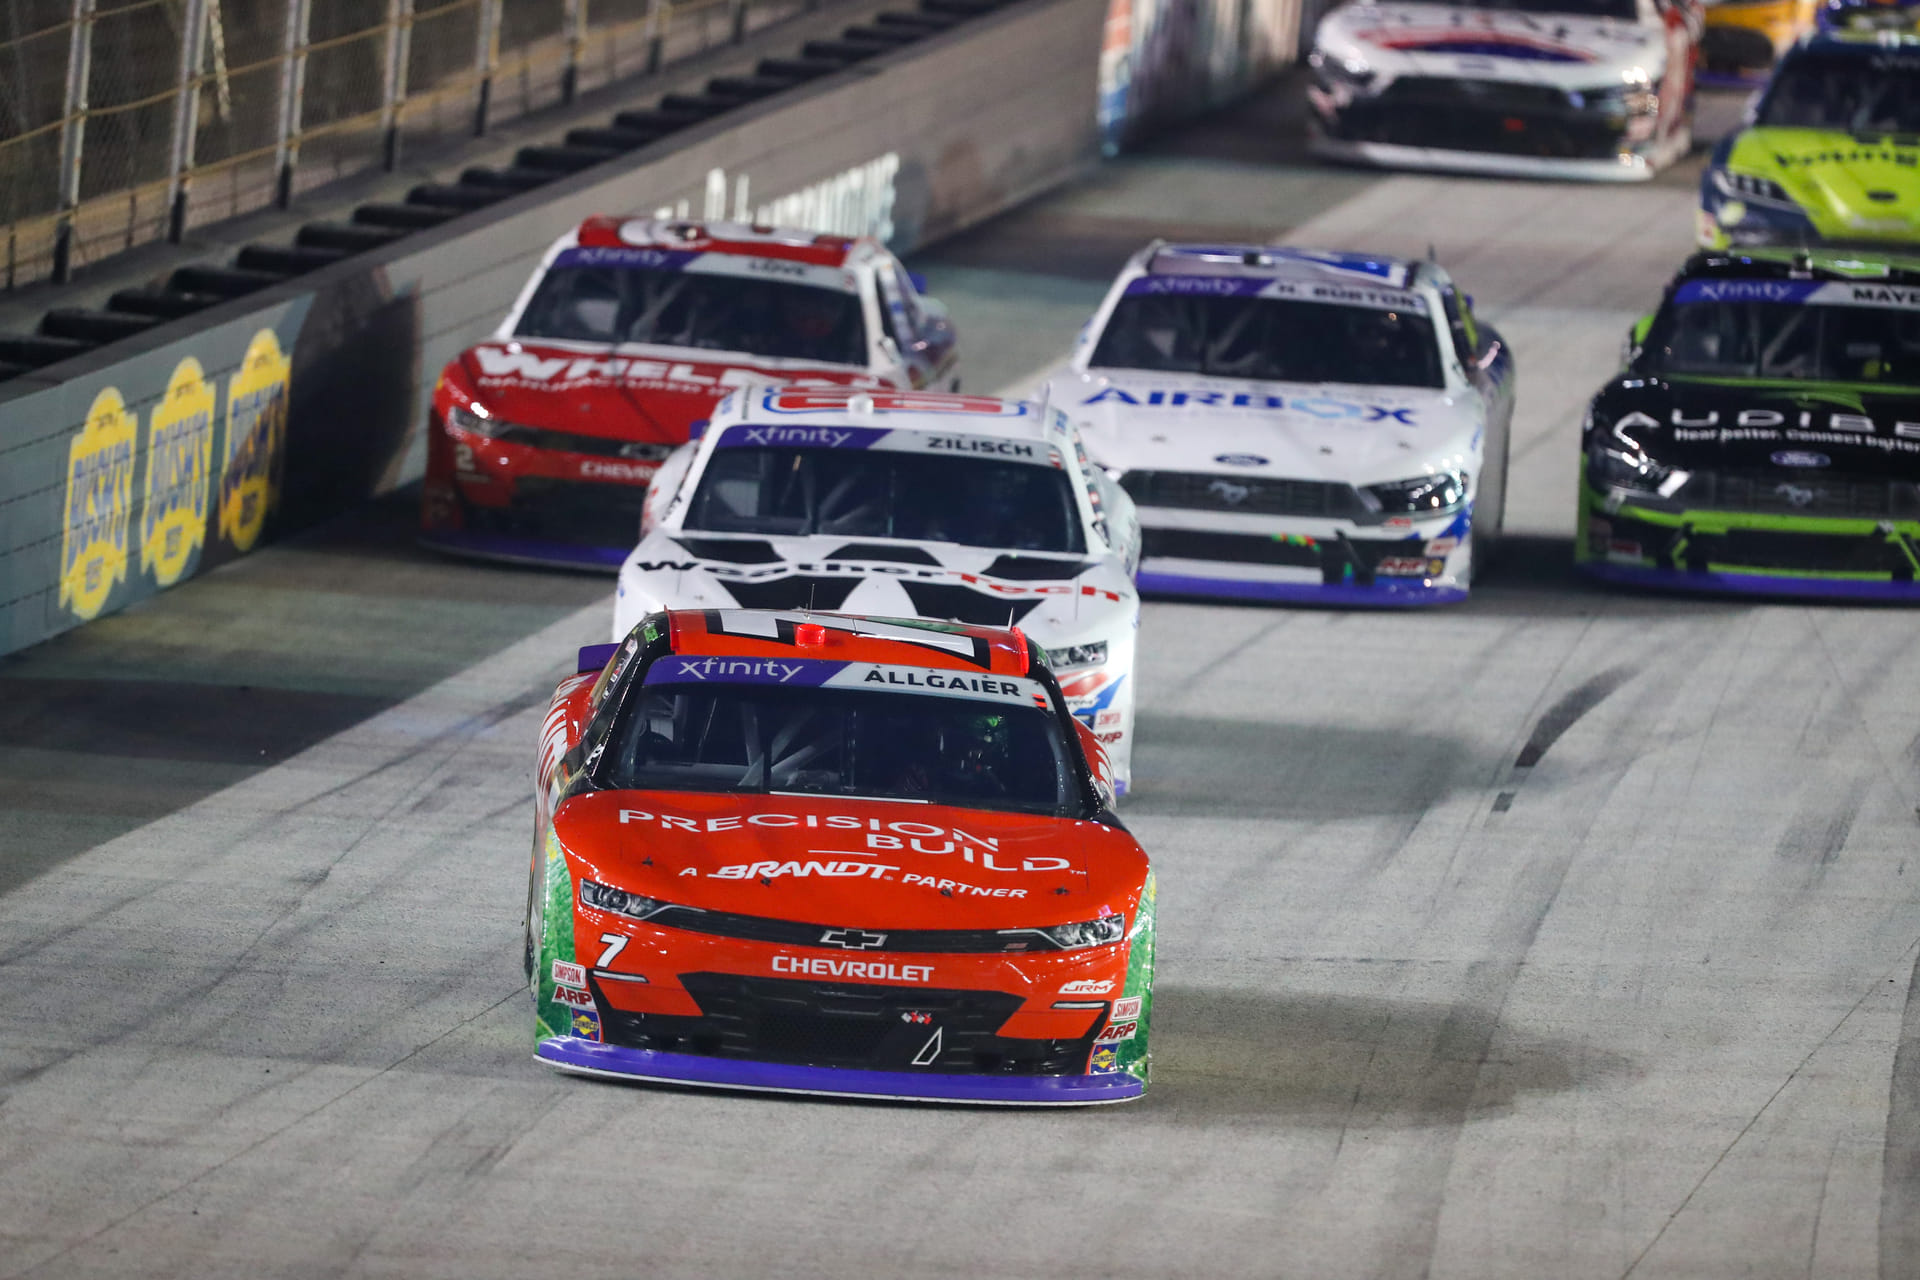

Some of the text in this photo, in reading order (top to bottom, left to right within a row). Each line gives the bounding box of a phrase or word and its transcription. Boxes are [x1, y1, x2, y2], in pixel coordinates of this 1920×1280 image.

[745, 426, 853, 448] xfinity
[1674, 428, 1717, 440] Hear
[927, 436, 1033, 457] ZILISCH
[637, 561, 1120, 602] WeatherTech
[678, 657, 804, 682] xfinity
[863, 669, 1022, 698] ALLGAIER
[618, 808, 1000, 852] PRECISION
[866, 833, 1071, 872] BUILD
[678, 860, 1028, 899] A BRANDT PARTNER
[598, 931, 631, 969] 7
[554, 963, 582, 984] SIMPSON
[772, 955, 936, 982] CHEVROLET
[555, 984, 593, 1005] ARP
[1063, 984, 1109, 992] JRM
[1113, 1001, 1140, 1018] SIMPSON
[573, 1019, 600, 1032] SUNOCO
[1097, 1021, 1137, 1040] ARP
